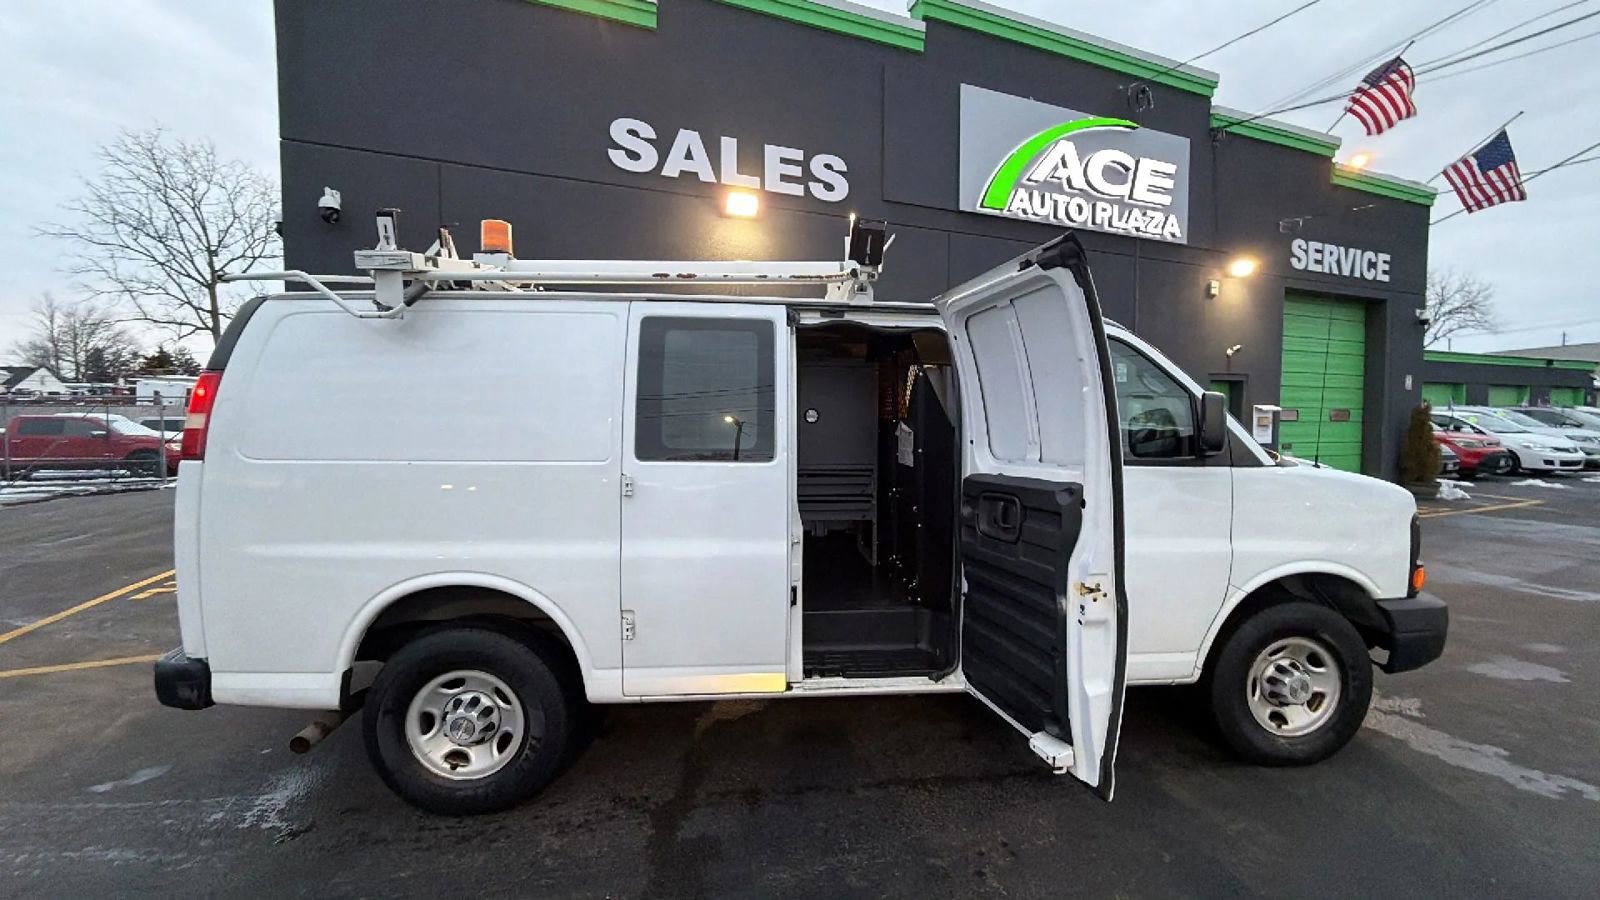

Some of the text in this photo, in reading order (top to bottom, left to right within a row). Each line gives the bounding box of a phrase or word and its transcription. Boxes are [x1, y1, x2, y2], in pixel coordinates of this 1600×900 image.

[607, 117, 849, 202] SALES
[1028, 139, 1177, 206] ACE
[1008, 188, 1182, 238] AUTO PLAZA
[1290, 238, 1391, 282] SERVICE
